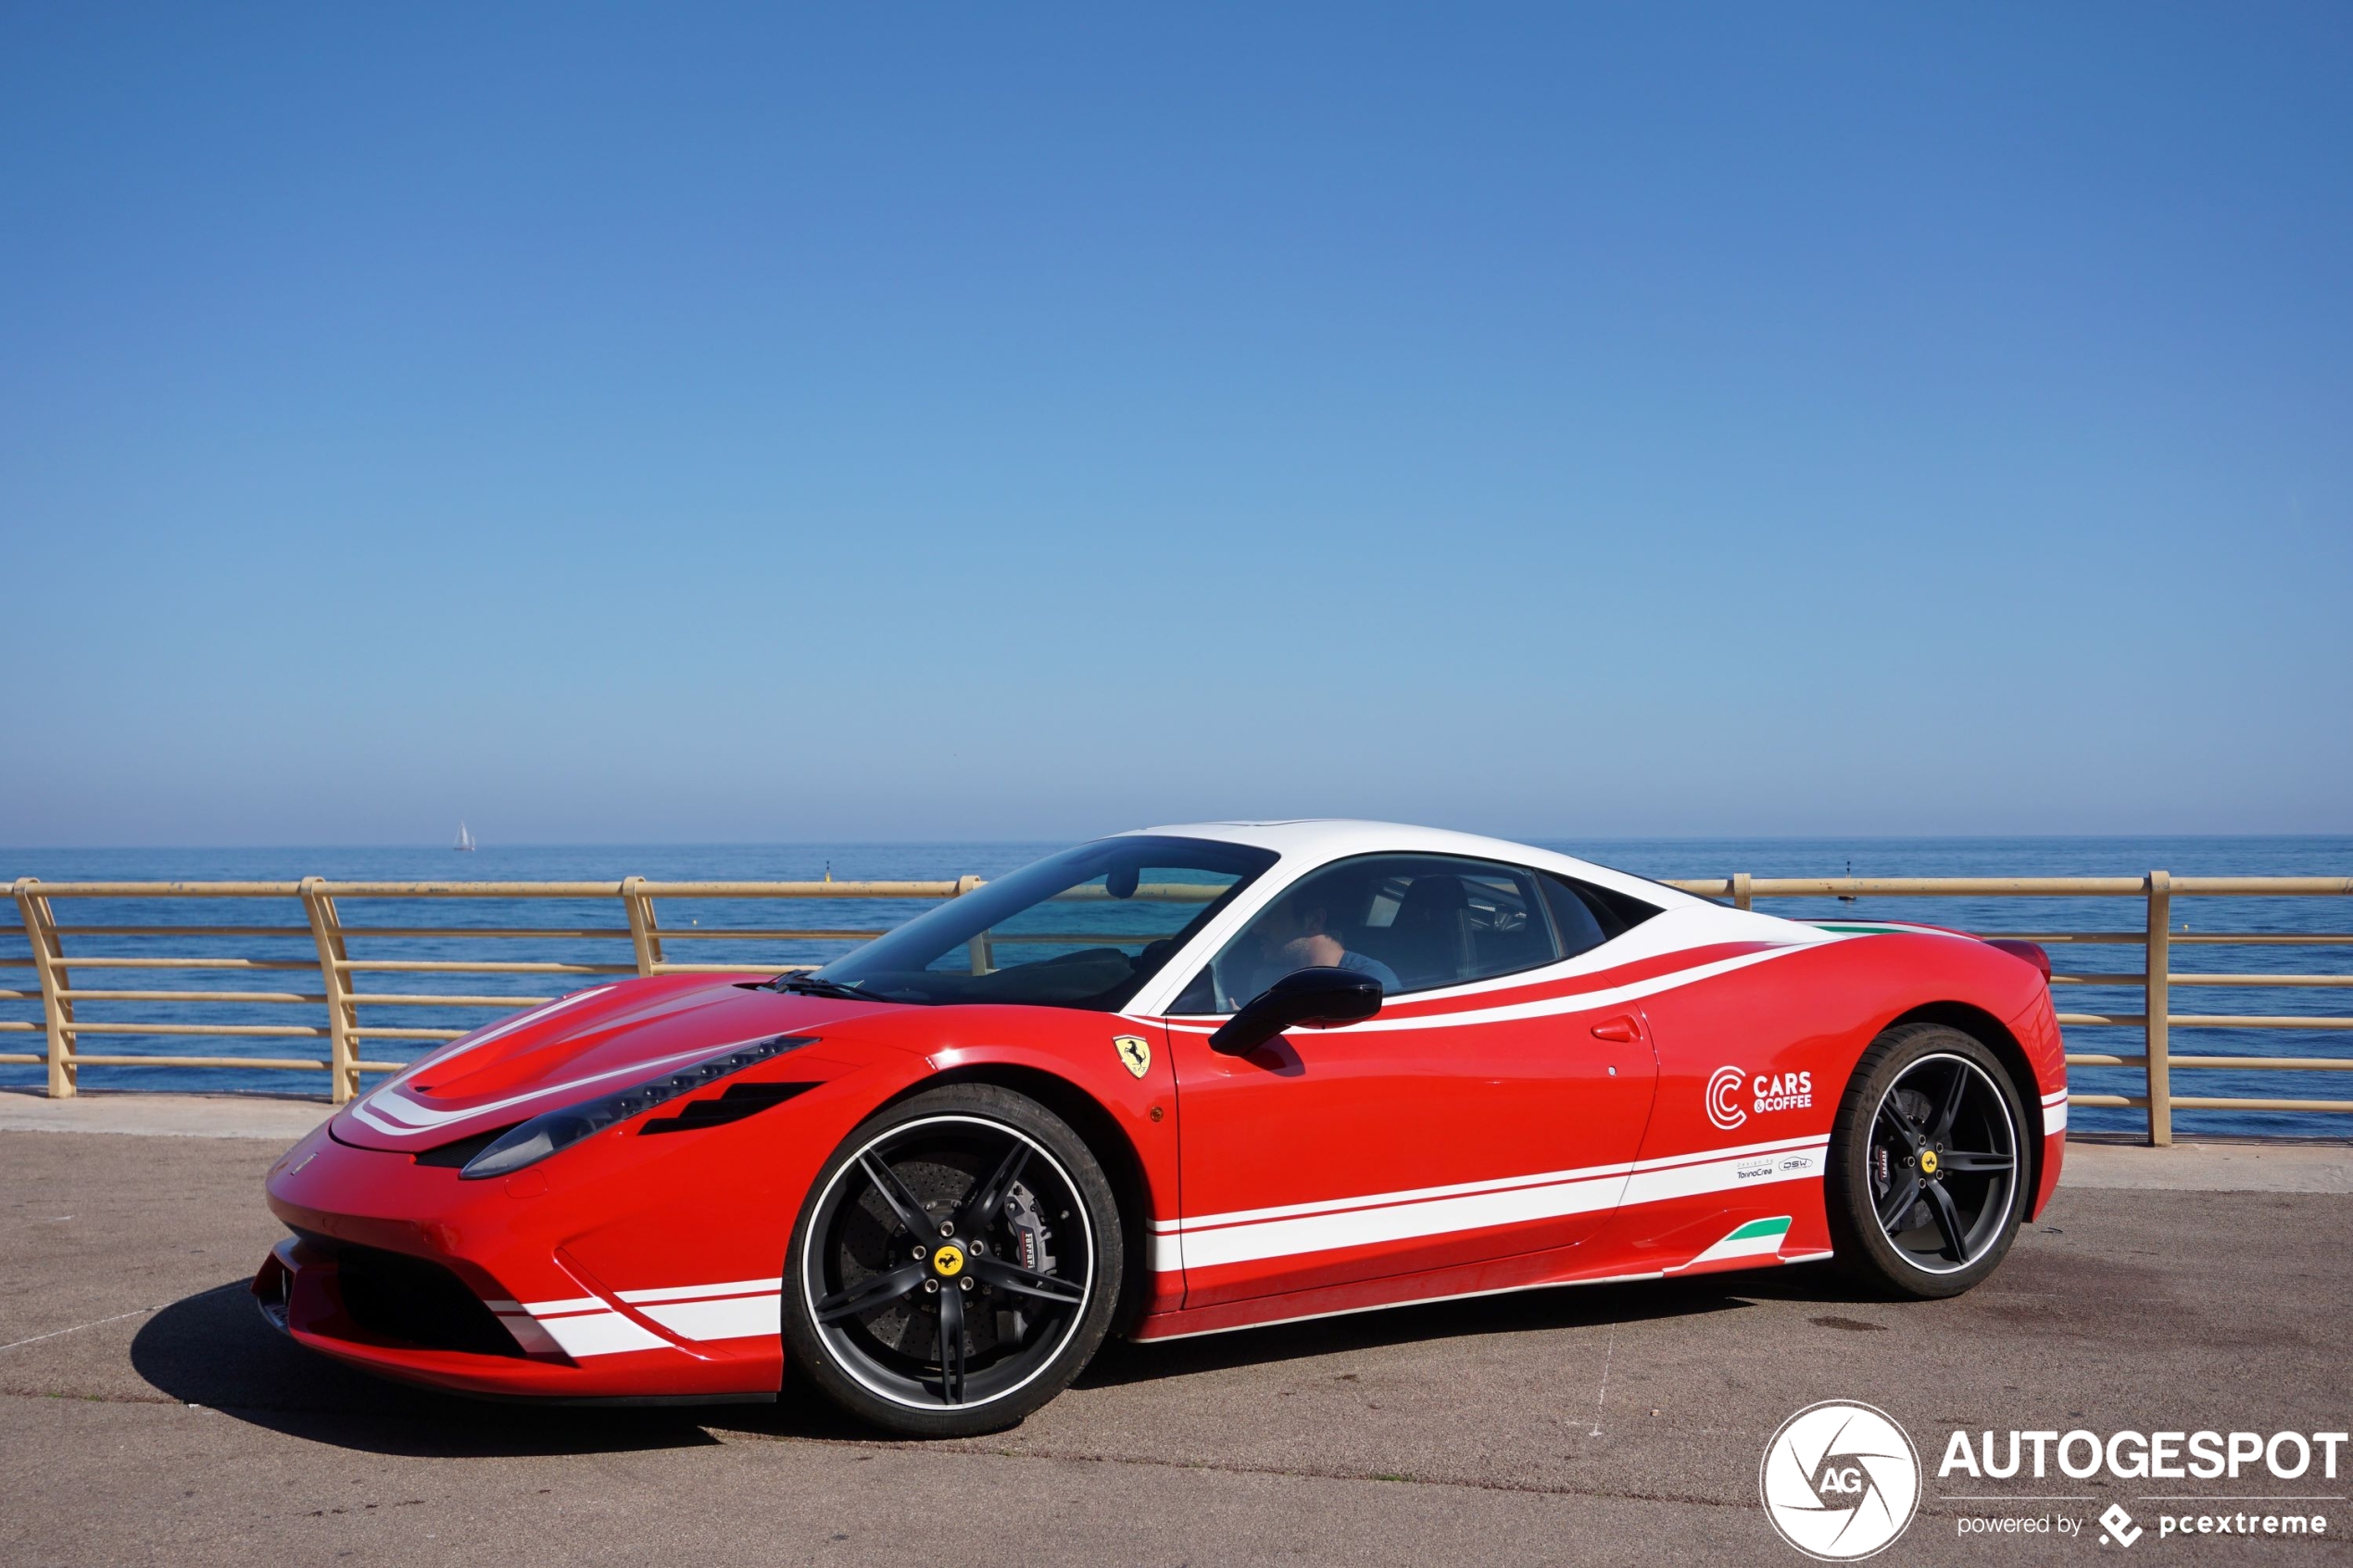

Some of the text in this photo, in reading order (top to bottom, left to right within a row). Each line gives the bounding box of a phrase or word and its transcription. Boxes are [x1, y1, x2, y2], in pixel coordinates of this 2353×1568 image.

[1754, 1071, 1812, 1098] CARS
[1754, 1094, 1812, 1113] &COFFEE
[1737, 1169, 1773, 1179] TorinoCrea
[1783, 1160, 1807, 1169] DSW
[1025, 1233, 1035, 1269] Ferrari
